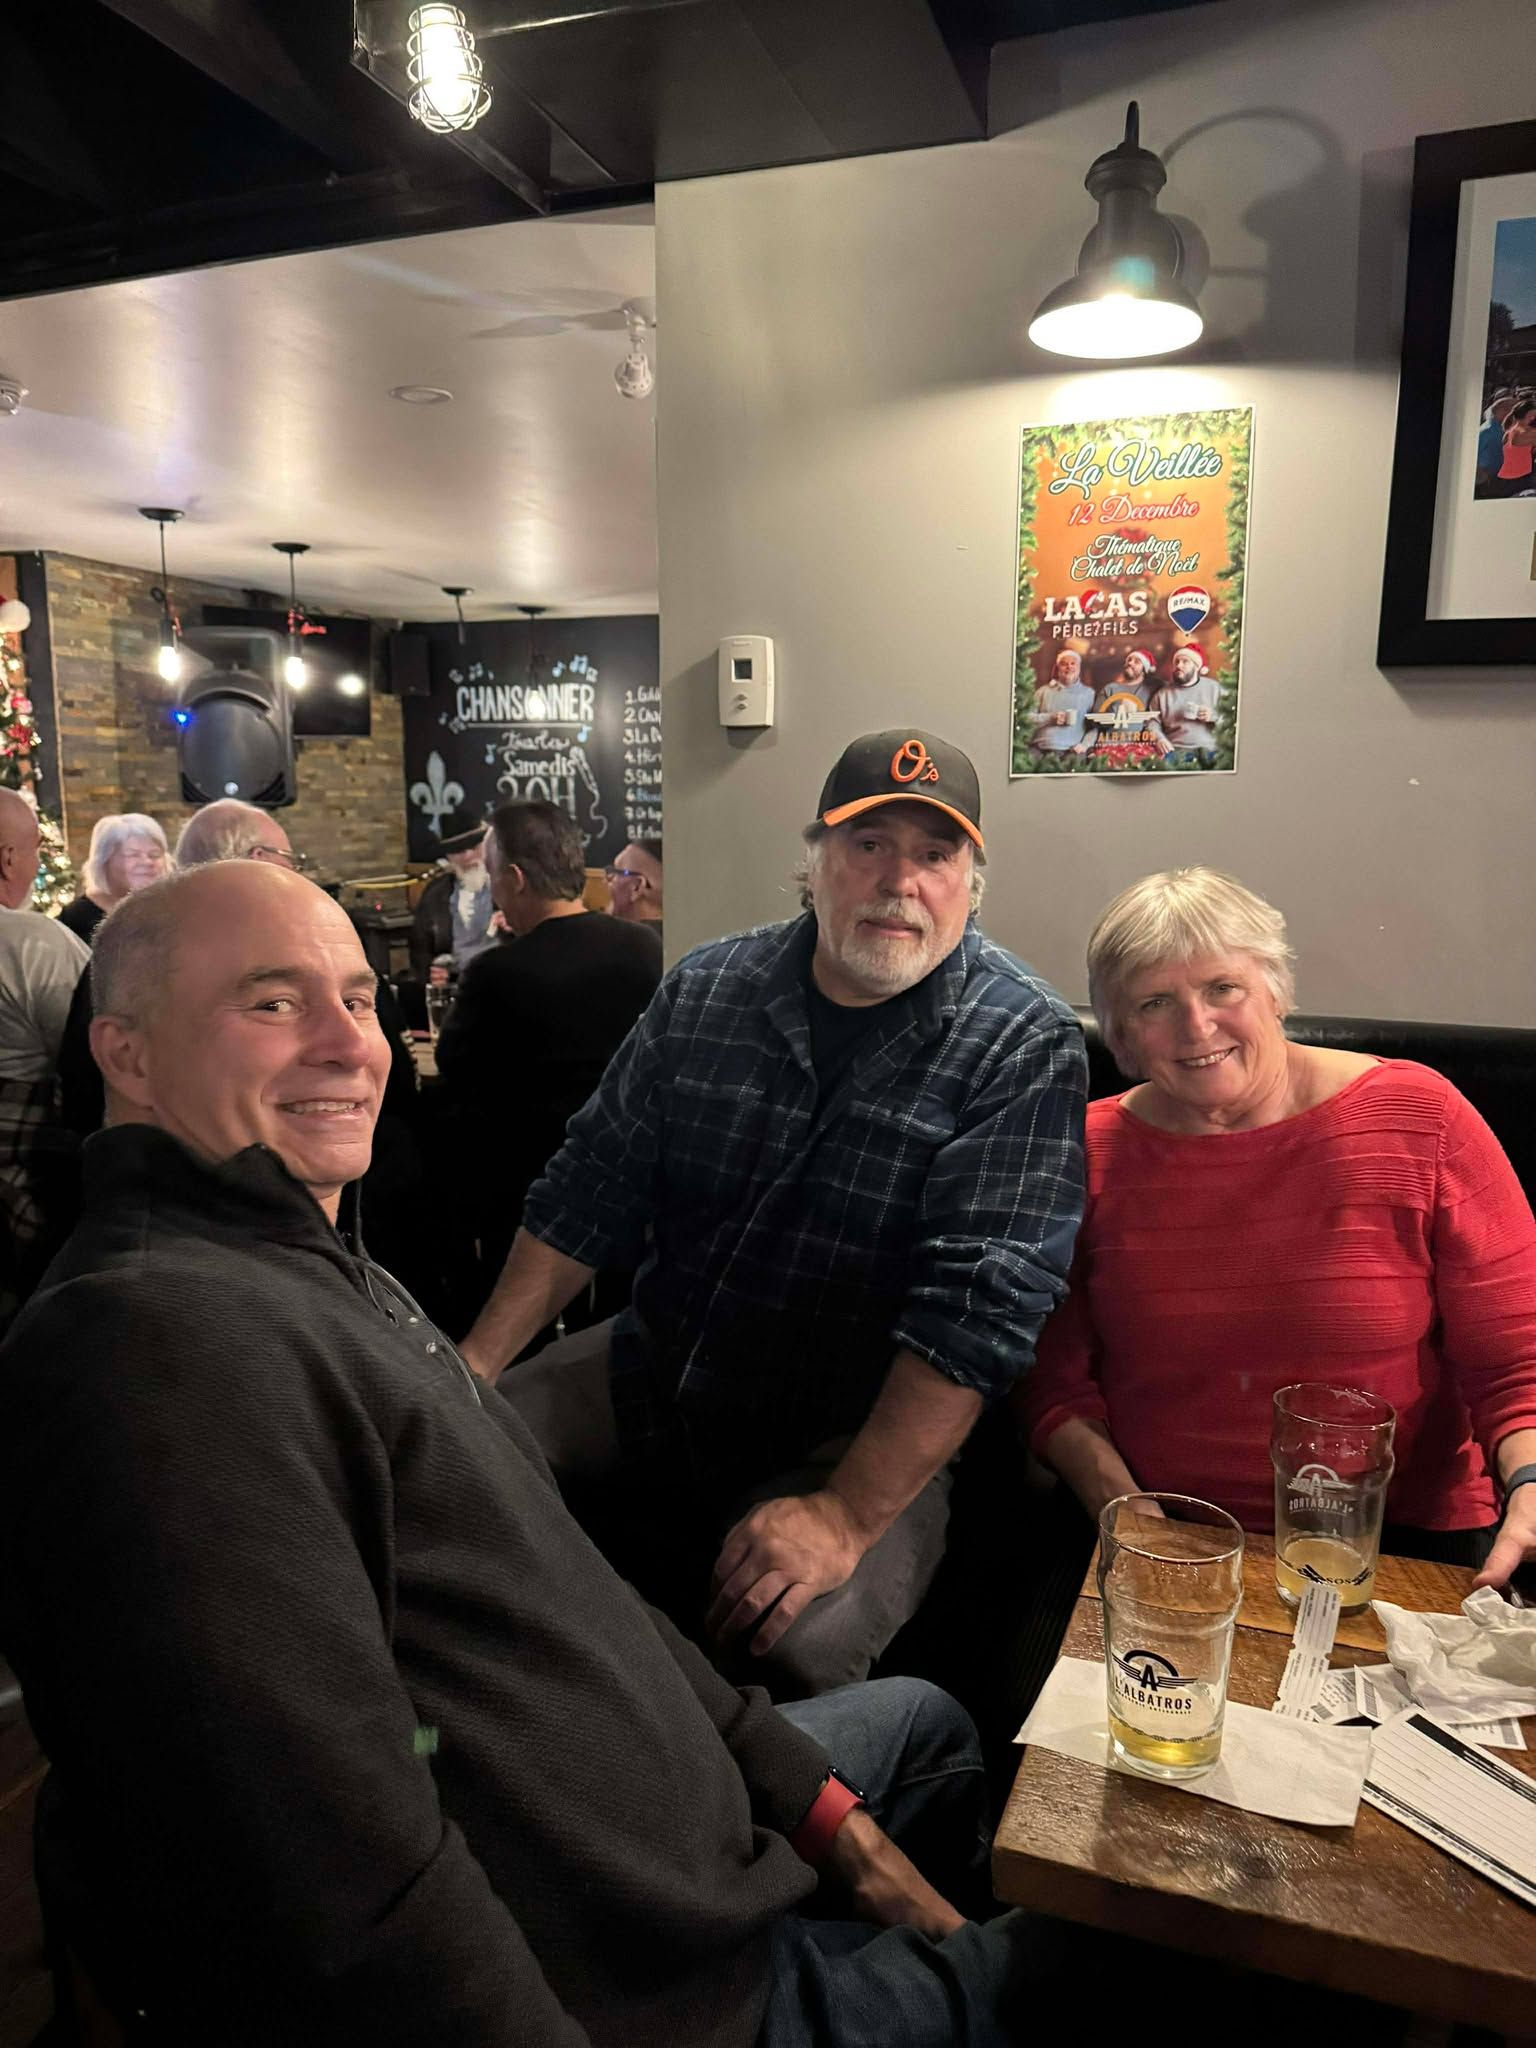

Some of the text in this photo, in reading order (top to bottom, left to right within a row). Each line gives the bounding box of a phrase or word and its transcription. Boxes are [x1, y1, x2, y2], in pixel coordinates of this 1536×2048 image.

[1049, 438, 1223, 499] La Veillée
[1068, 503, 1095, 526] 12
[1087, 533, 1182, 560] Thématique
[1070, 552, 1200, 582] Chalet de Noël
[1044, 590, 1148, 622] LACAS
[1173, 596, 1205, 607] RE/MAX
[503, 751, 577, 778] Samedis
[890, 739, 940, 782] O's
[1114, 1676, 1192, 1710] L'ALBATROS
